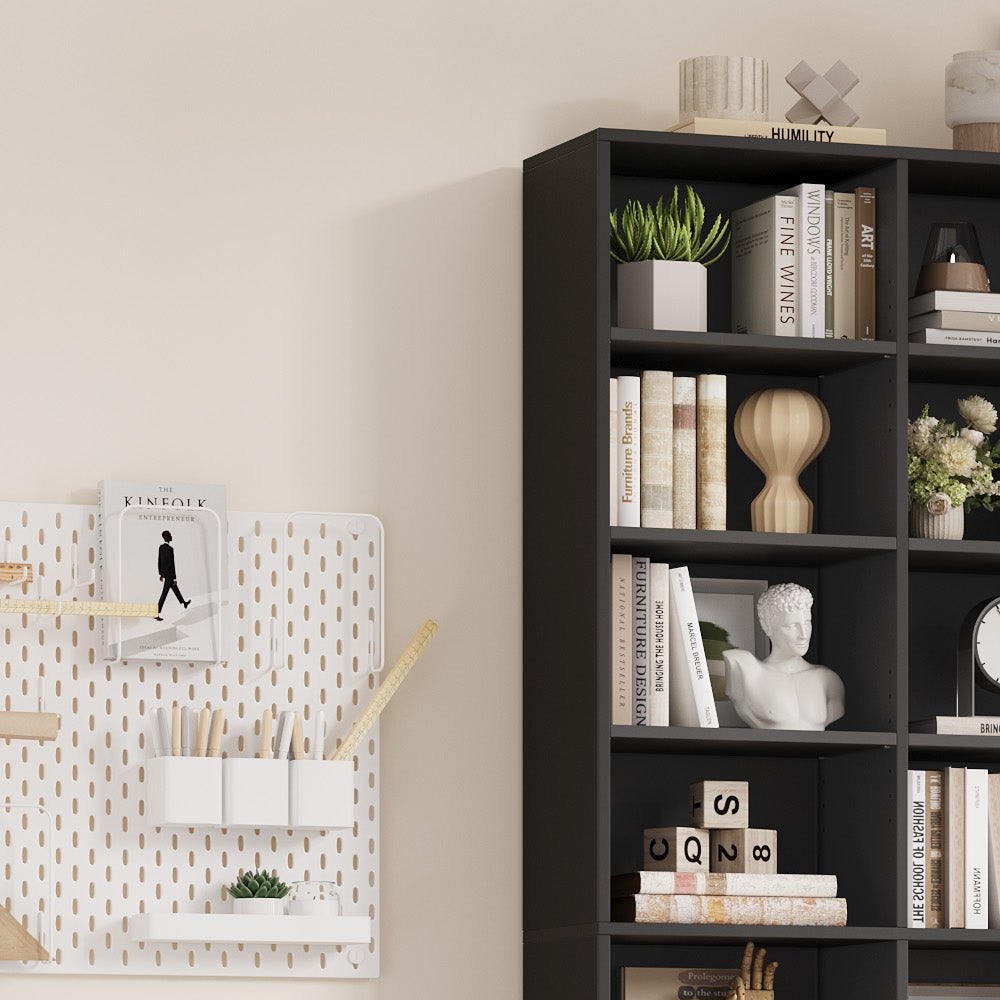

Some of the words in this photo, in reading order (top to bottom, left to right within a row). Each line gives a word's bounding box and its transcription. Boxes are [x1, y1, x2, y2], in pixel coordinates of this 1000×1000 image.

[772, 128, 834, 142] HUMILITY
[806, 189, 820, 254] WINDOWS
[780, 216, 794, 256] FINE
[862, 224, 874, 250] ART
[780, 265, 794, 324] WINES
[622, 402, 632, 445] Brands
[622, 448, 632, 503] Furniture
[636, 561, 646, 659] FURNITURE
[656, 601, 664, 618] HOME
[656, 619, 664, 643] HOUSE
[656, 644, 664, 657] THE
[687, 622, 698, 650] MARCEL
[693, 651, 704, 680] BREUER
[656, 664, 664, 692] BRINGING
[636, 665, 646, 726] DESIGN
[714, 794, 740, 815] S
[649, 838, 669, 861] C
[684, 836, 702, 865] Q
[718, 844, 737, 862] 2
[753, 845, 771, 862] 8
[688, 972, 735, 983] Prolegome
